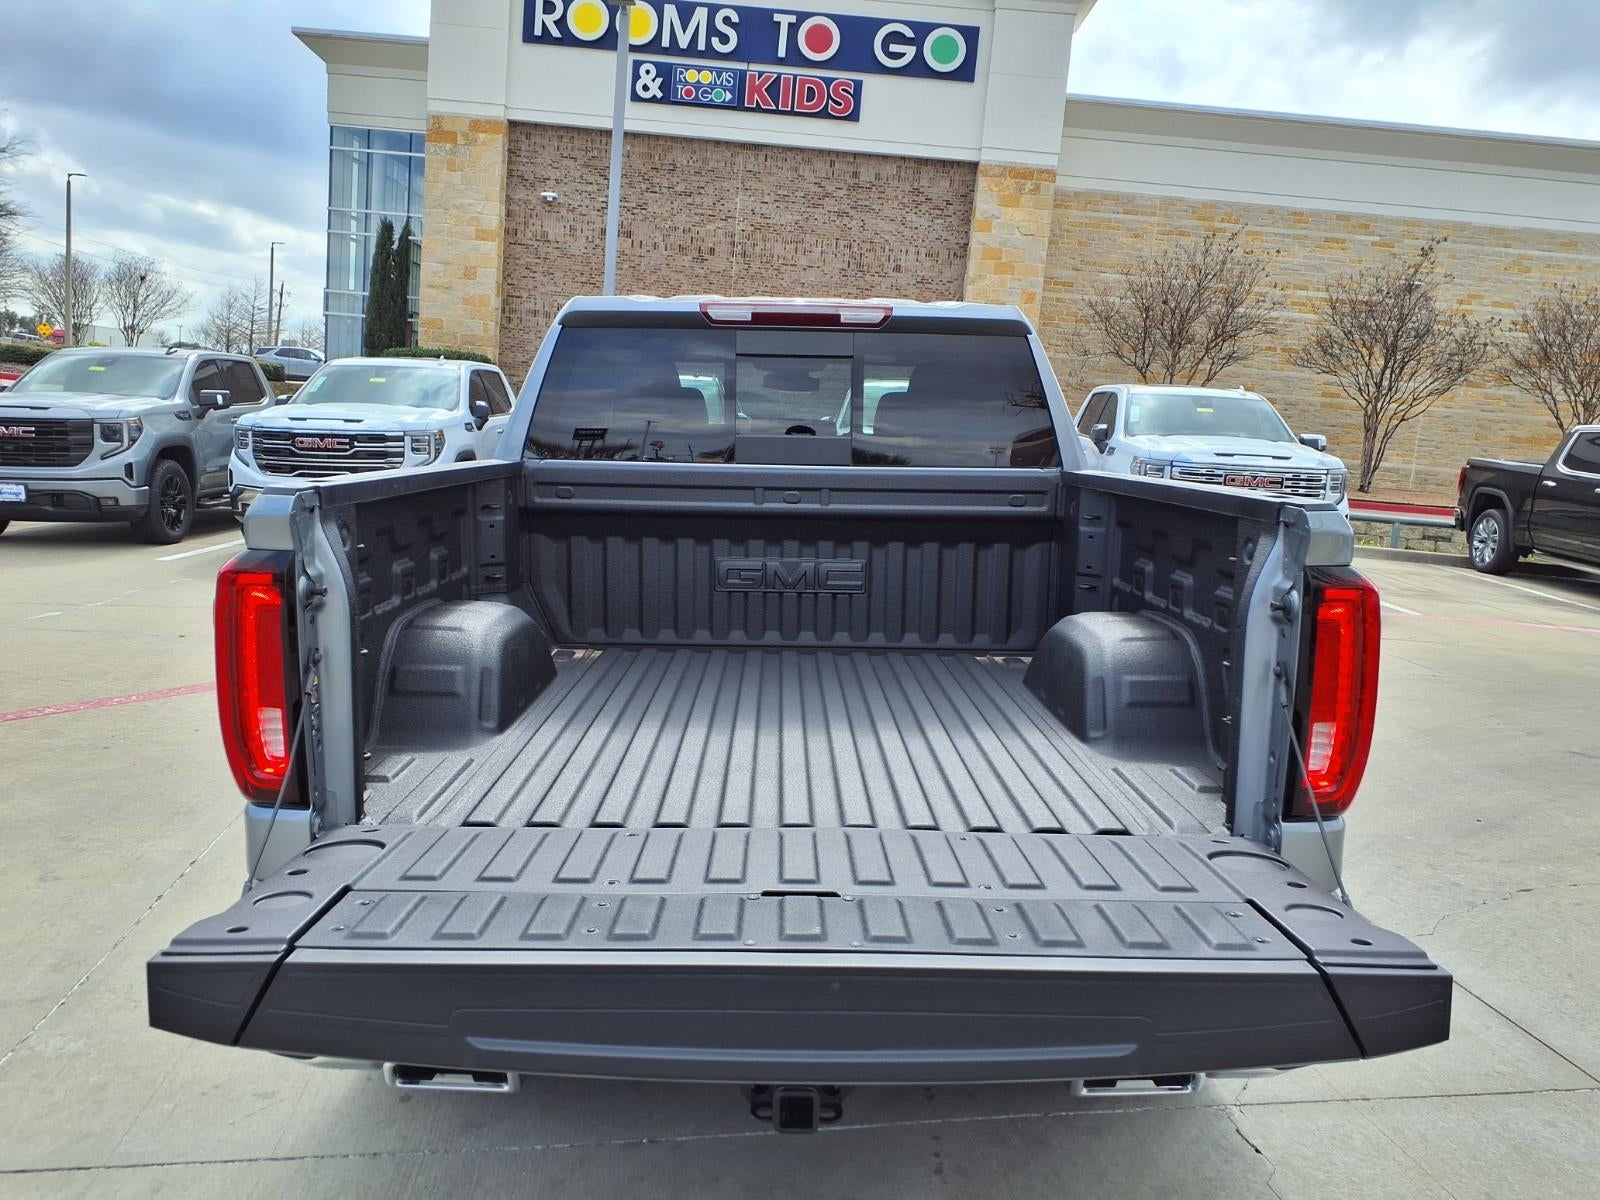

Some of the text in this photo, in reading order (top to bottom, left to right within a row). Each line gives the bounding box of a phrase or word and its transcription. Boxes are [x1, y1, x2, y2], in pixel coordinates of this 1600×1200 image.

[533, 0, 967, 73] ROOMS TO GO
[635, 62, 664, 99] &
[676, 67, 734, 86] ROOMS
[676, 85, 726, 102] TO GO
[744, 71, 855, 117] KIDS
[0, 426, 35, 437] MC
[295, 437, 350, 449] GMC
[1225, 474, 1282, 489] GMC
[717, 560, 865, 591] GMC
